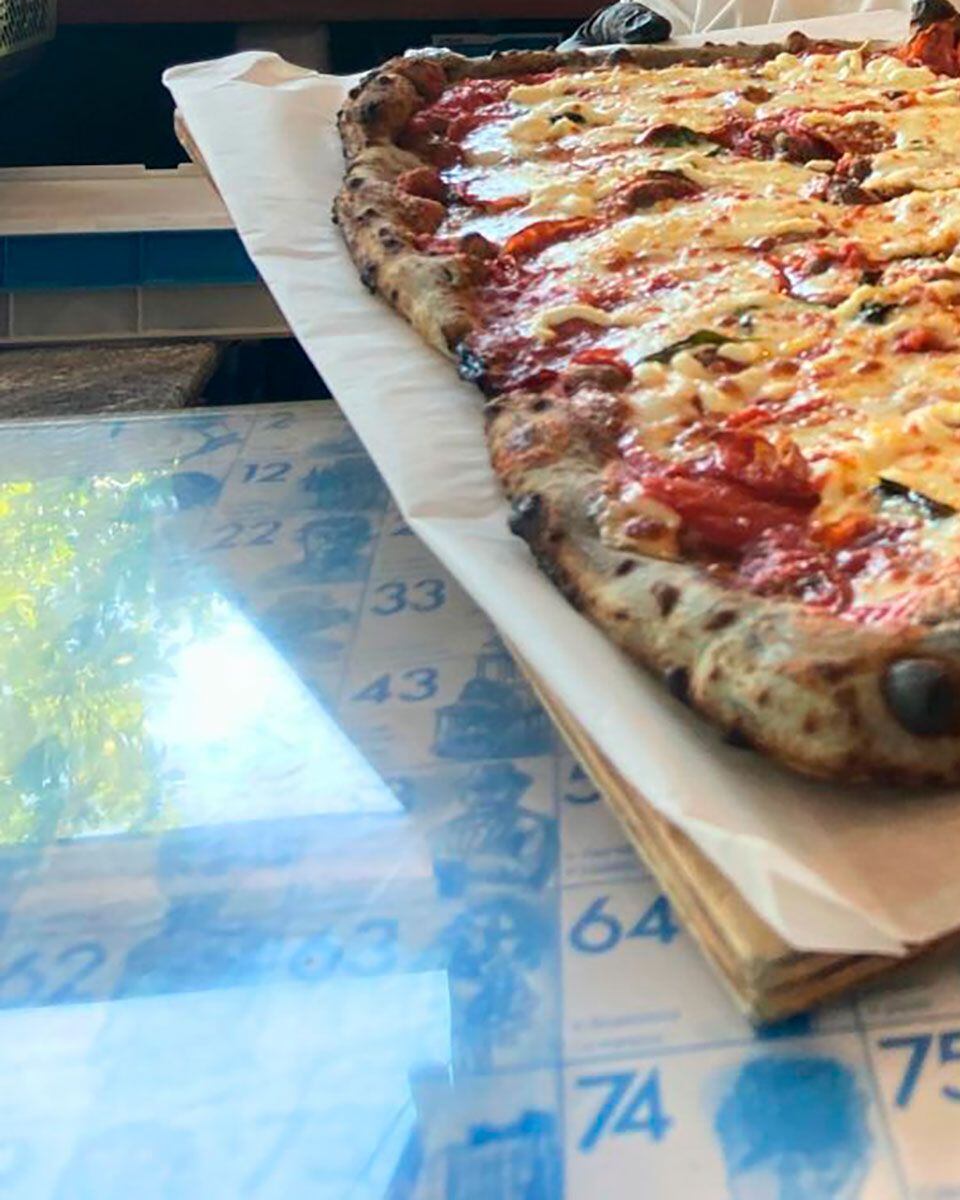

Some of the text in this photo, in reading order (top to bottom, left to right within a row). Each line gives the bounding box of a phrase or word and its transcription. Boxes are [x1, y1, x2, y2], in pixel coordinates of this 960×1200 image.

[242, 461, 293, 483] 12
[209, 520, 282, 550] 22
[370, 578, 448, 616] 33
[351, 666, 440, 704] 43
[288, 917, 400, 981] 63
[570, 895, 679, 955] 64
[575, 1067, 672, 1155] 74
